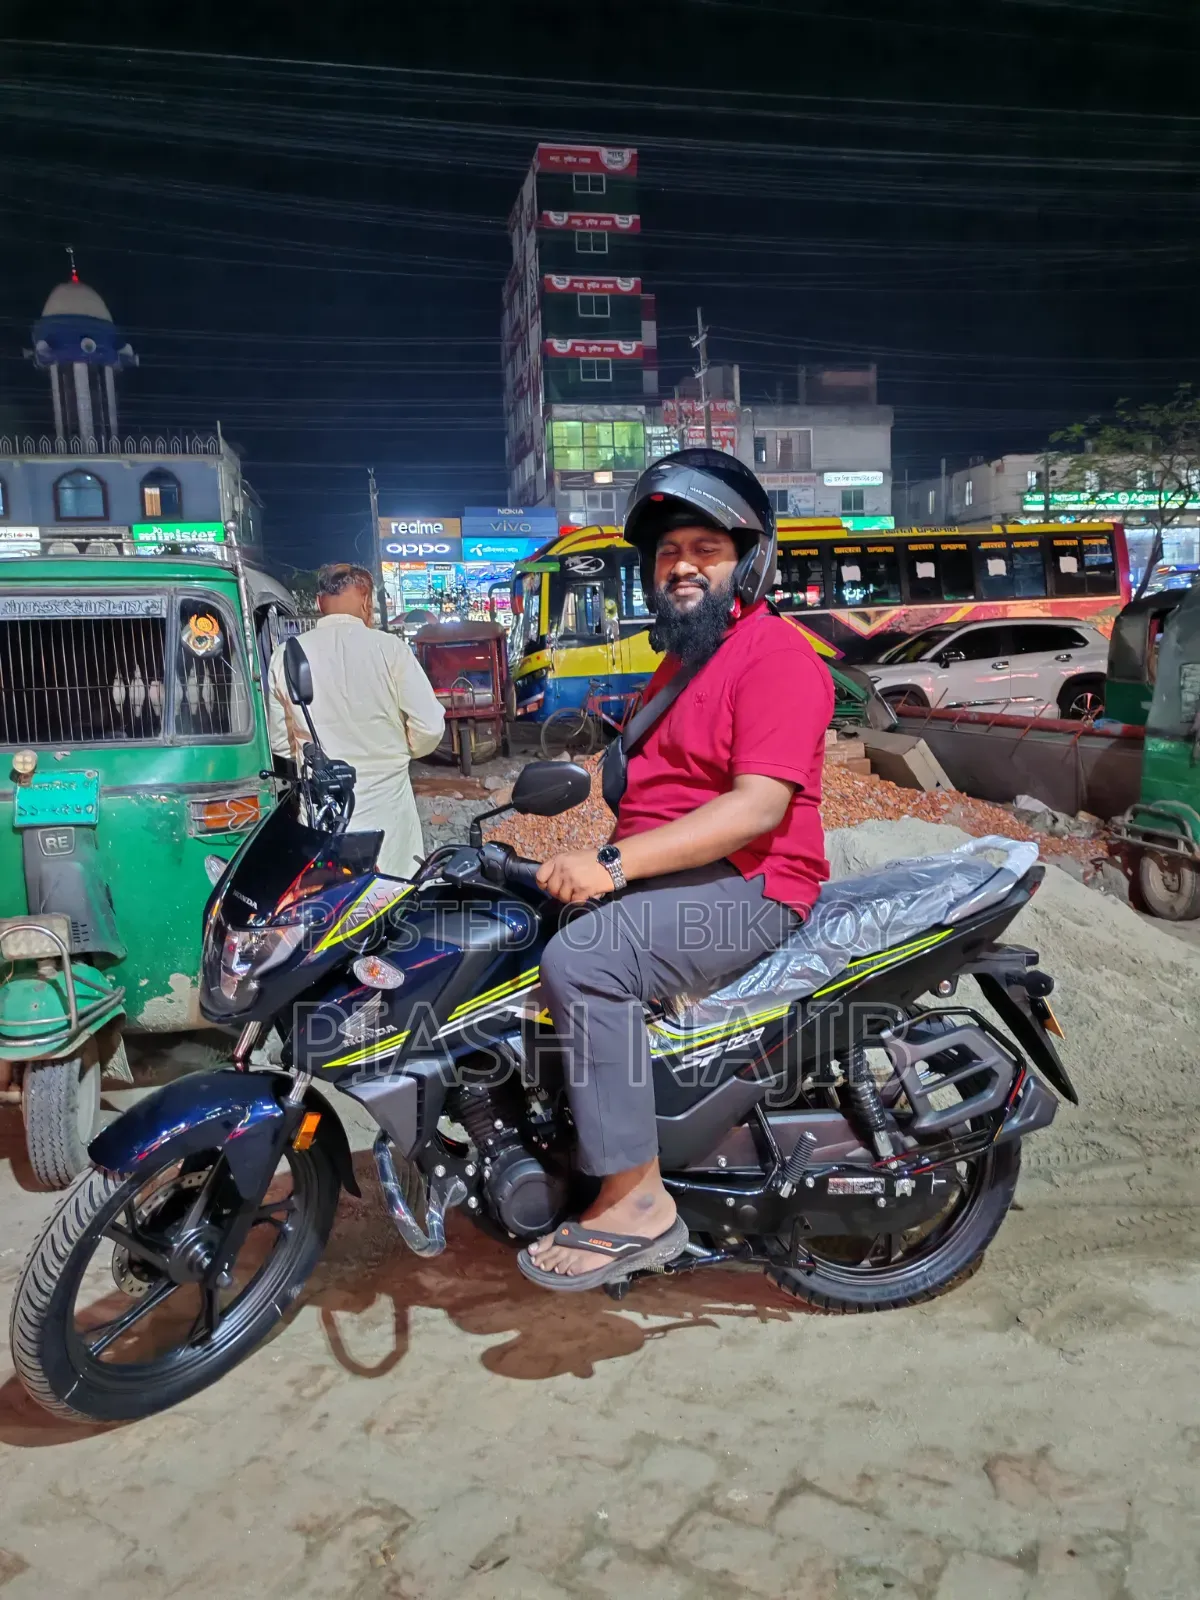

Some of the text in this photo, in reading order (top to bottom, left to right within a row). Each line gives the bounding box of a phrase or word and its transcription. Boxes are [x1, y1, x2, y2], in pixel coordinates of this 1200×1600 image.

[390, 520, 444, 535] realme
[490, 520, 532, 533] vivo
[45, 836, 69, 850] RE
[232, 889, 258, 910] HONDA
[342, 1024, 398, 1048] HONDA
